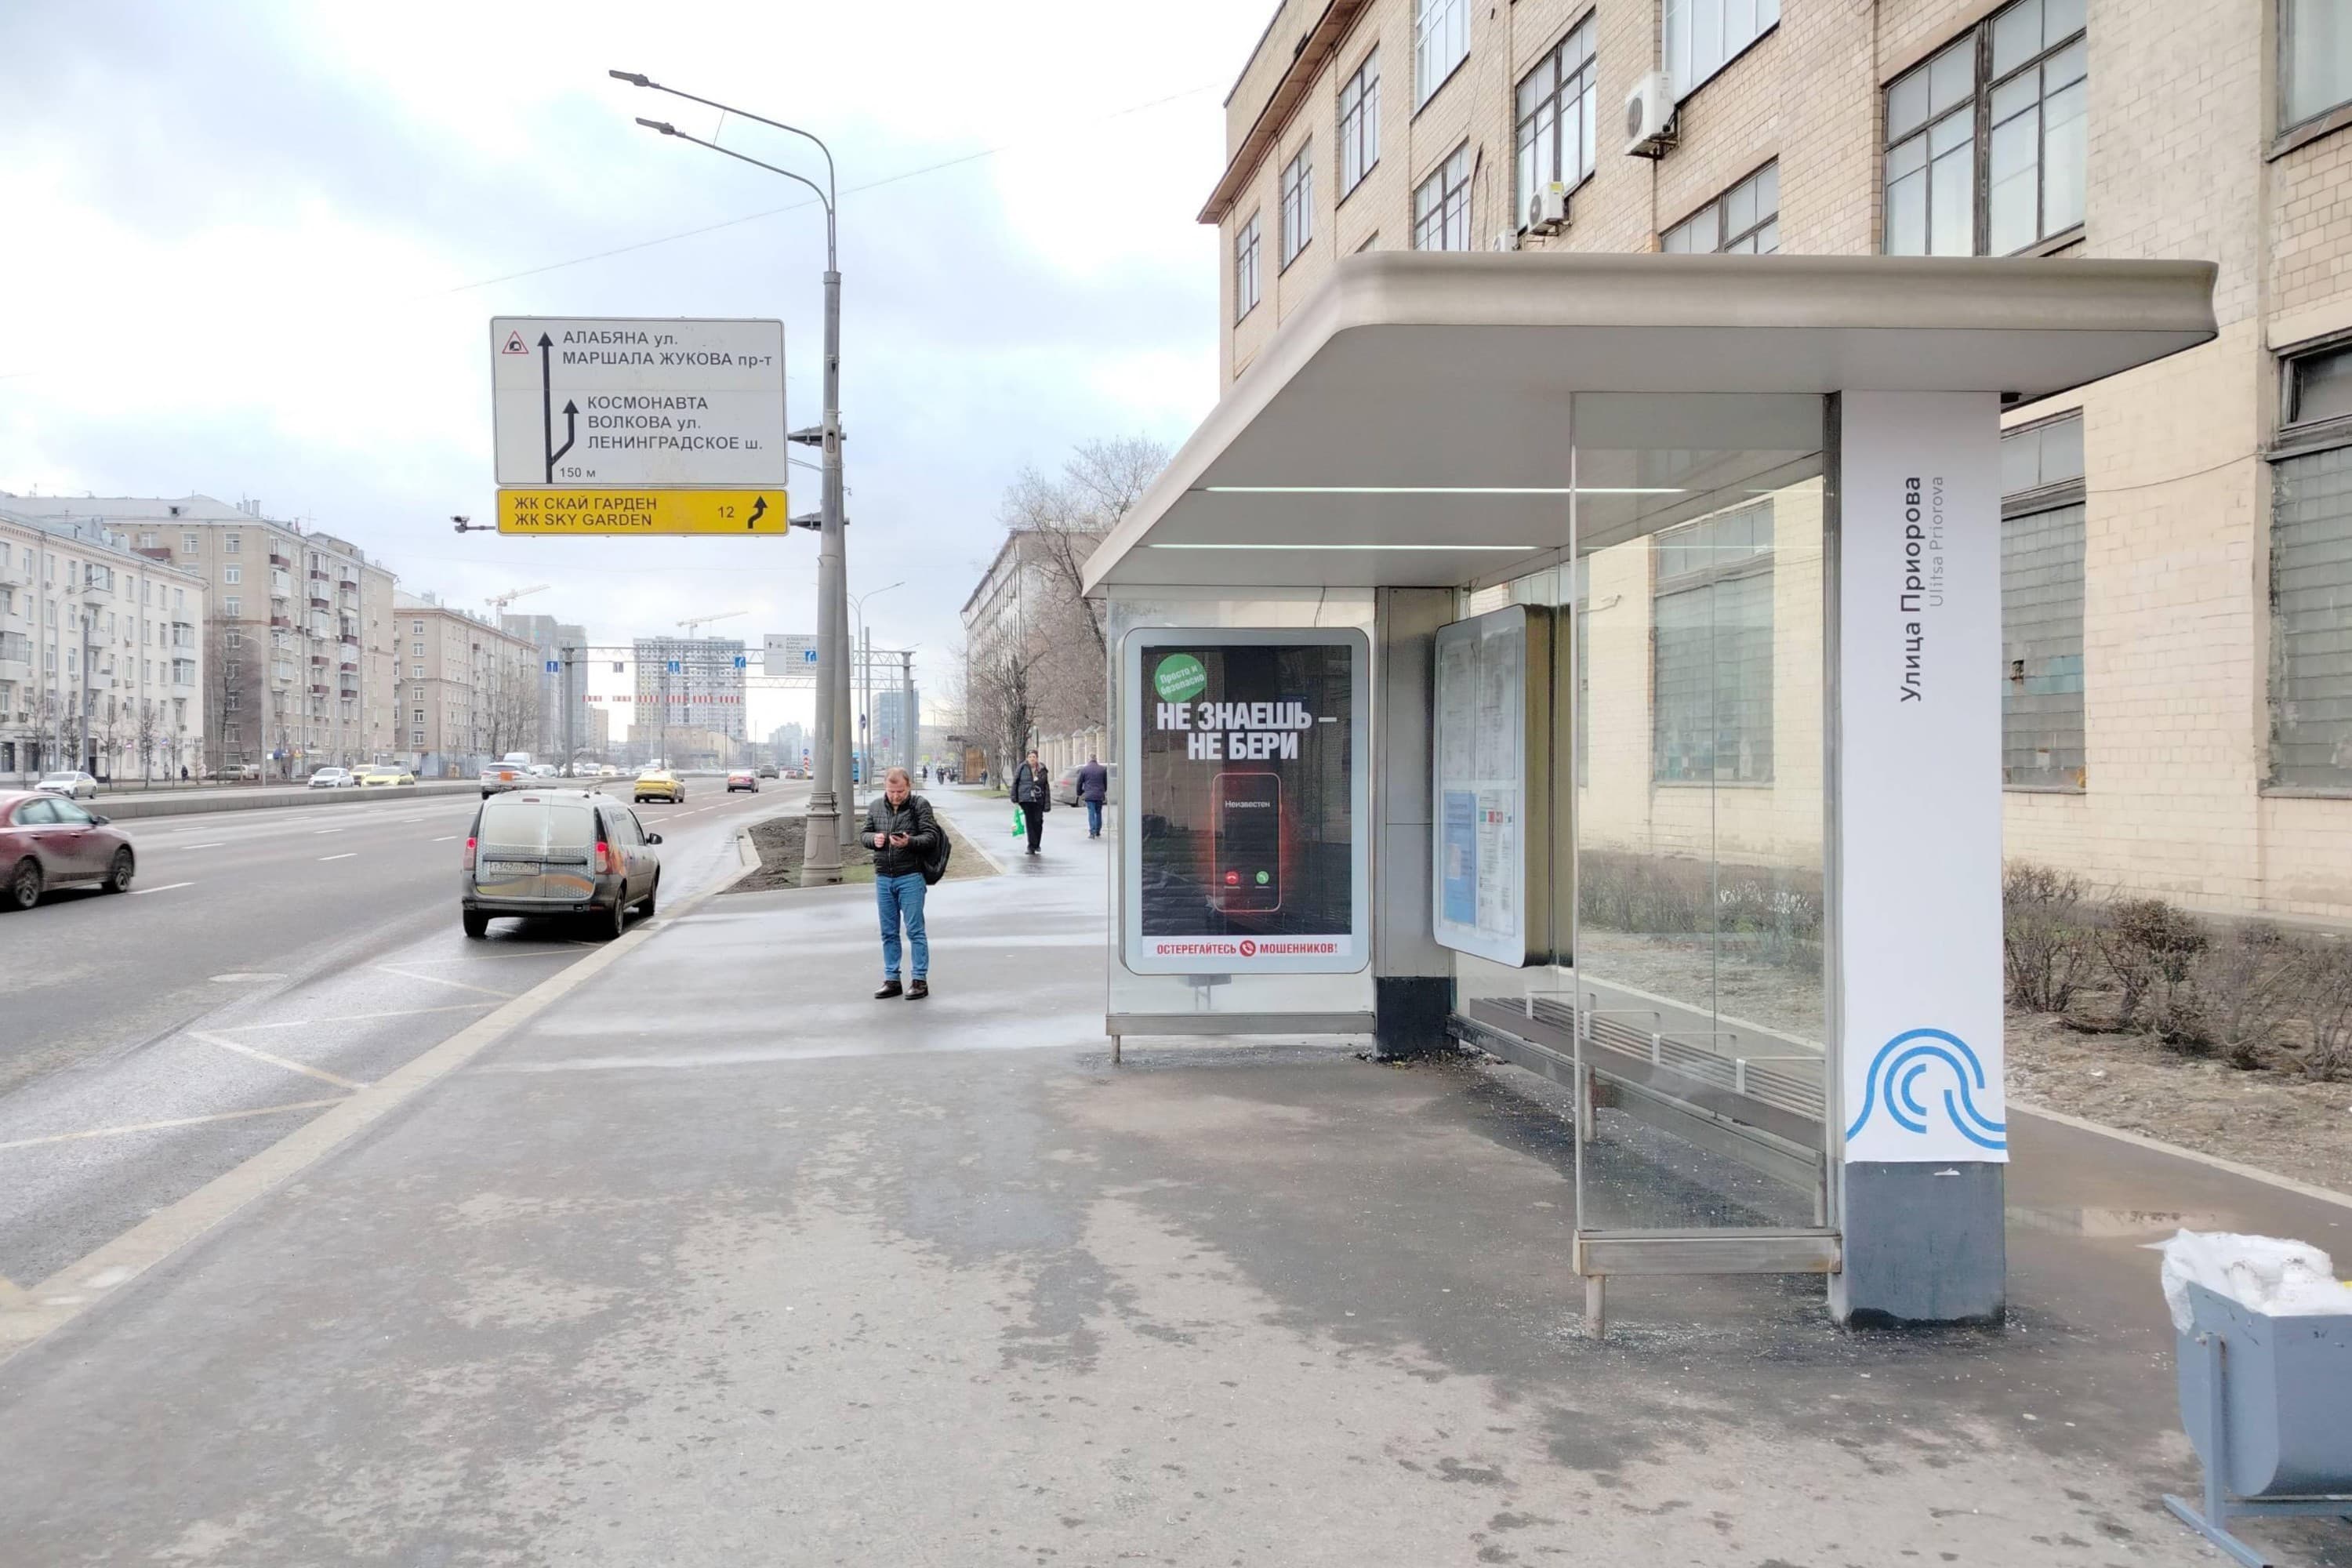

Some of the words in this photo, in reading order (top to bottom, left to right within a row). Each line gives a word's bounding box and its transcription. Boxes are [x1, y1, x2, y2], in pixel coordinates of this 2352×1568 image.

[563, 331, 648, 345] АЛАБЯНА
[654, 335, 678, 347] ул.
[563, 352, 655, 365] МАРШАЛА
[659, 352, 733, 366] ЖУКОВА
[739, 355, 771, 369] пр-т
[588, 396, 708, 410] КОСМОНАВТА
[588, 416, 672, 429] ВОЛКОВА
[677, 418, 702, 432] ул.
[588, 436, 739, 452] ЛЕНИНГРАДСКОЕ
[745, 438, 763, 450] ш.
[560, 467, 582, 478] 150
[586, 470, 596, 478] м
[514, 497, 538, 510] ЖК
[544, 495, 589, 510] СКАЙ
[594, 497, 658, 512] ГАРДЕН
[717, 506, 735, 518] 12
[1929, 476, 1944, 550] Priorova
[514, 514, 538, 526] ЖК
[544, 514, 578, 526] SKY
[583, 514, 652, 527] GARDEN
[1900, 477, 1926, 612] Приорова
[1929, 556, 1944, 607] Ulitsa
[1900, 622, 1924, 702] Улица
[1160, 668, 1191, 684] Просто
[1156, 702, 1192, 730] НЕ
[1197, 702, 1312, 731] ЗНАЕШЬ
[1188, 732, 1222, 760] НЕ
[1229, 732, 1298, 760] БЕРИ
[1157, 942, 1236, 955] ОСТЕРЕГАЙТЕСЬ
[1260, 943, 1338, 954] МОШЕННИКОВ!
